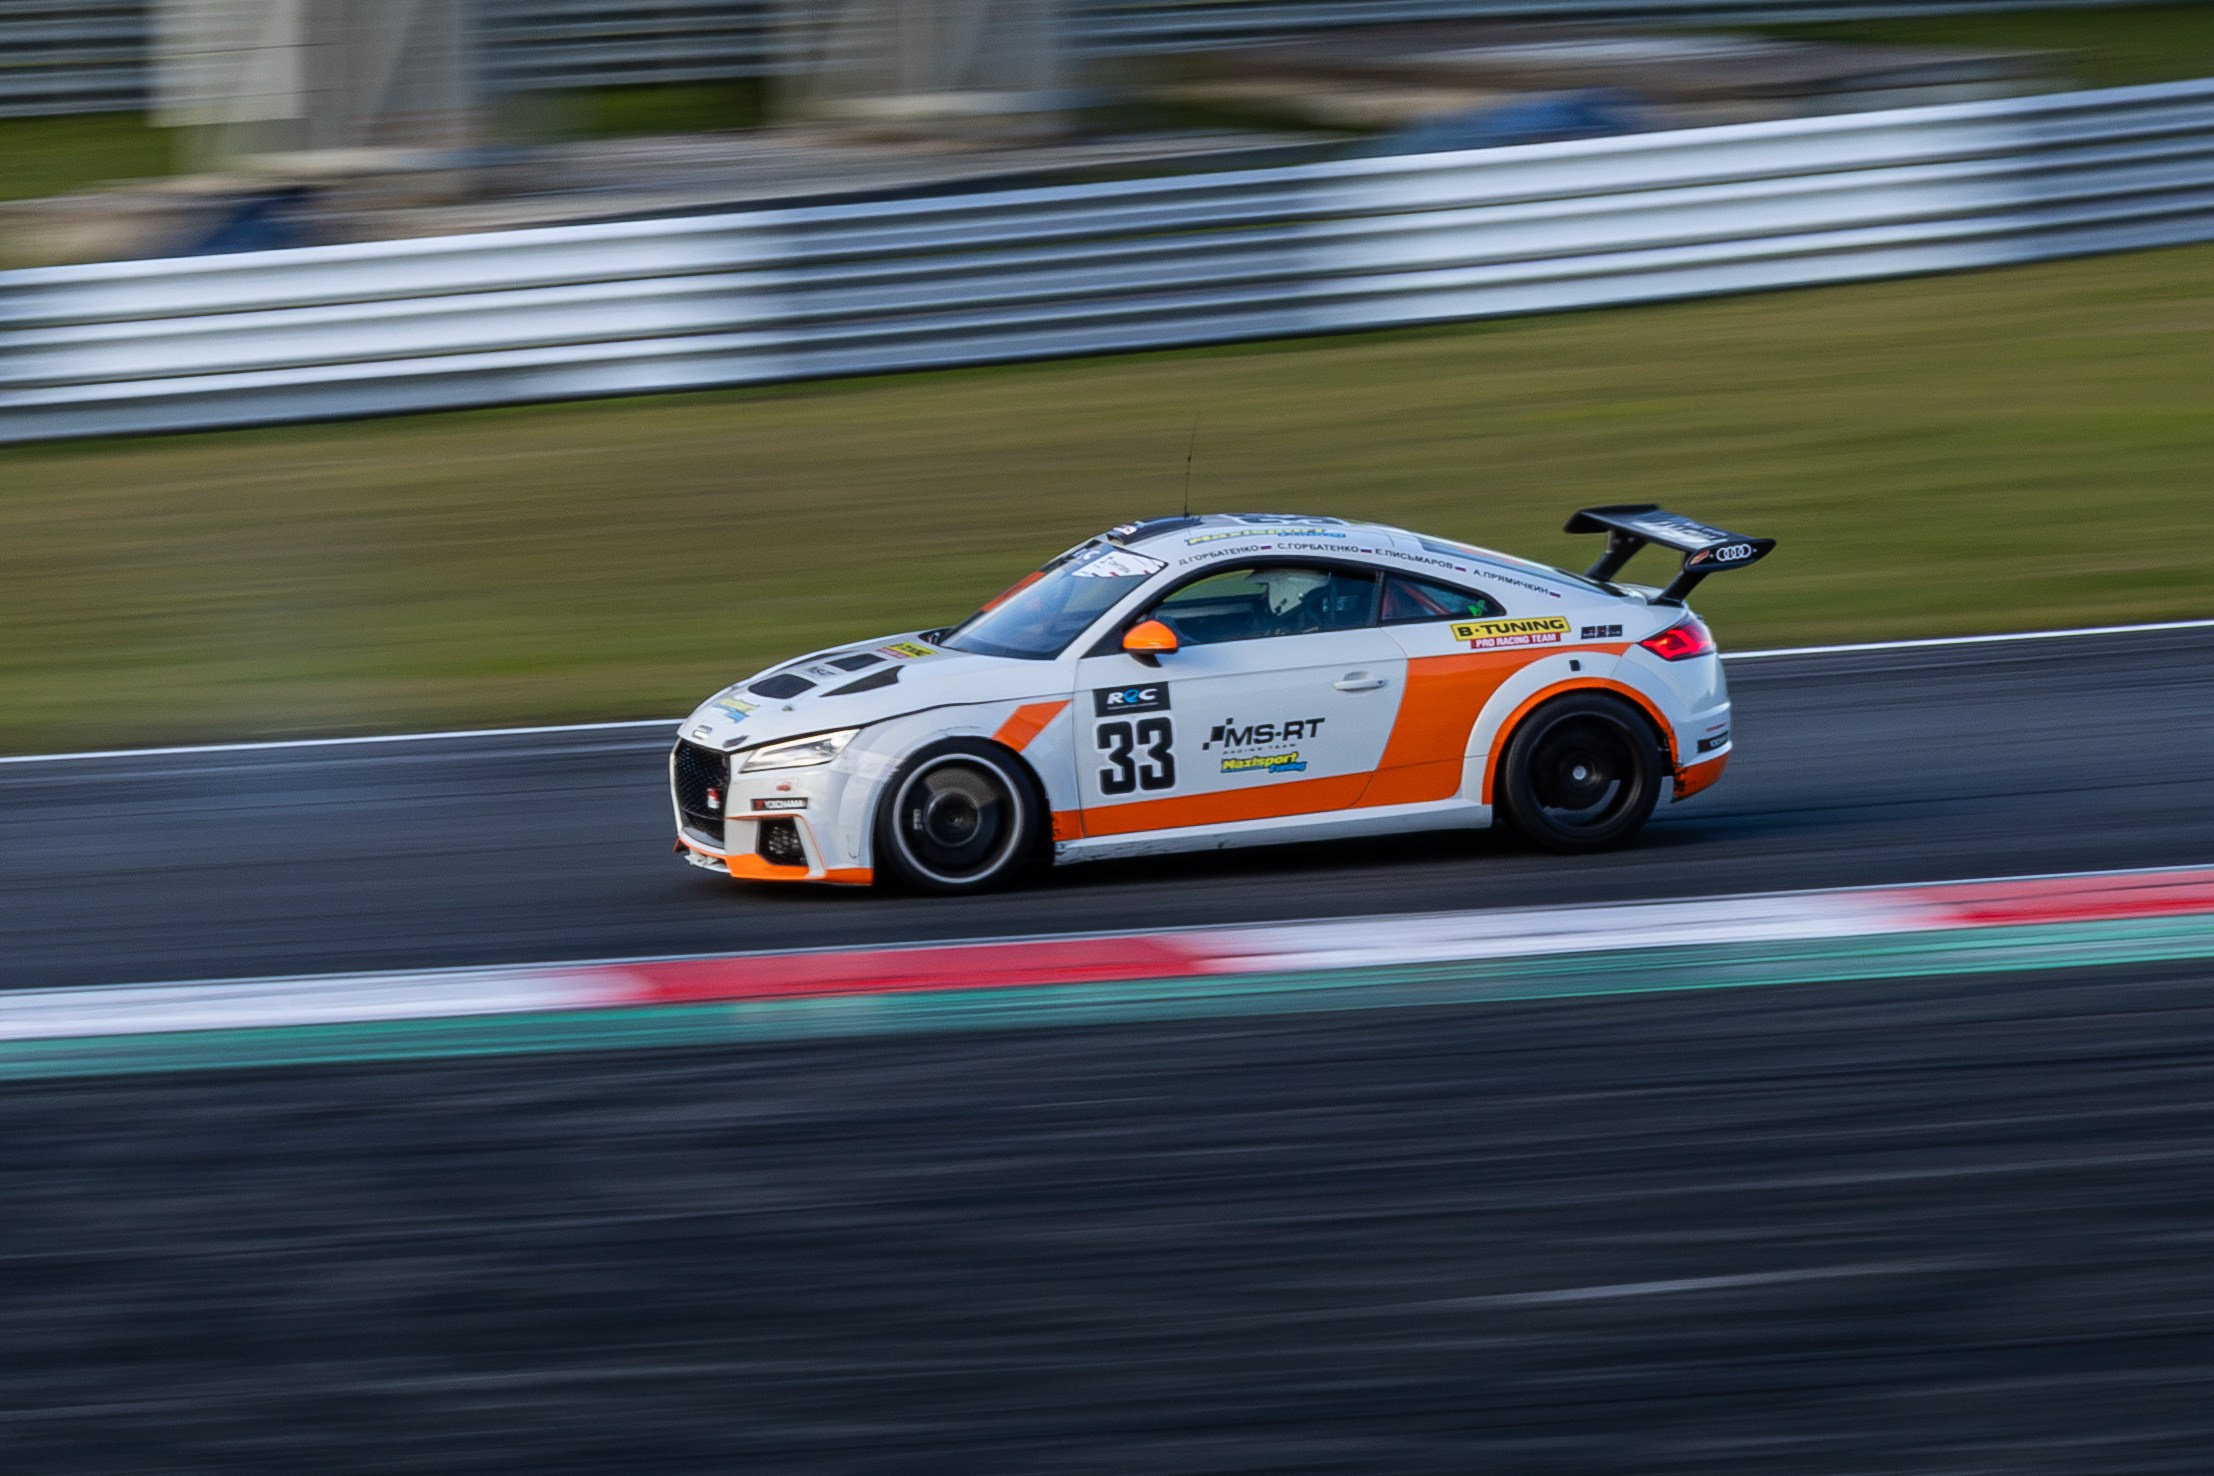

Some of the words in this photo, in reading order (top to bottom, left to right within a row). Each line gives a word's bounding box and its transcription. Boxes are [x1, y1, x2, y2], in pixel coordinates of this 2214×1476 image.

[1277, 541, 1359, 554] С.ГОРБАТЕНКО
[1375, 547, 1453, 570] Е.ПИСЬМАРОВ
[1476, 637, 1495, 648] PRO
[1497, 635, 1530, 646] RACING
[1531, 632, 1557, 644] TEAM
[1223, 716, 1326, 748] MS-RT
[1096, 716, 1176, 796] 33
[1220, 751, 1299, 770] Maxisport
